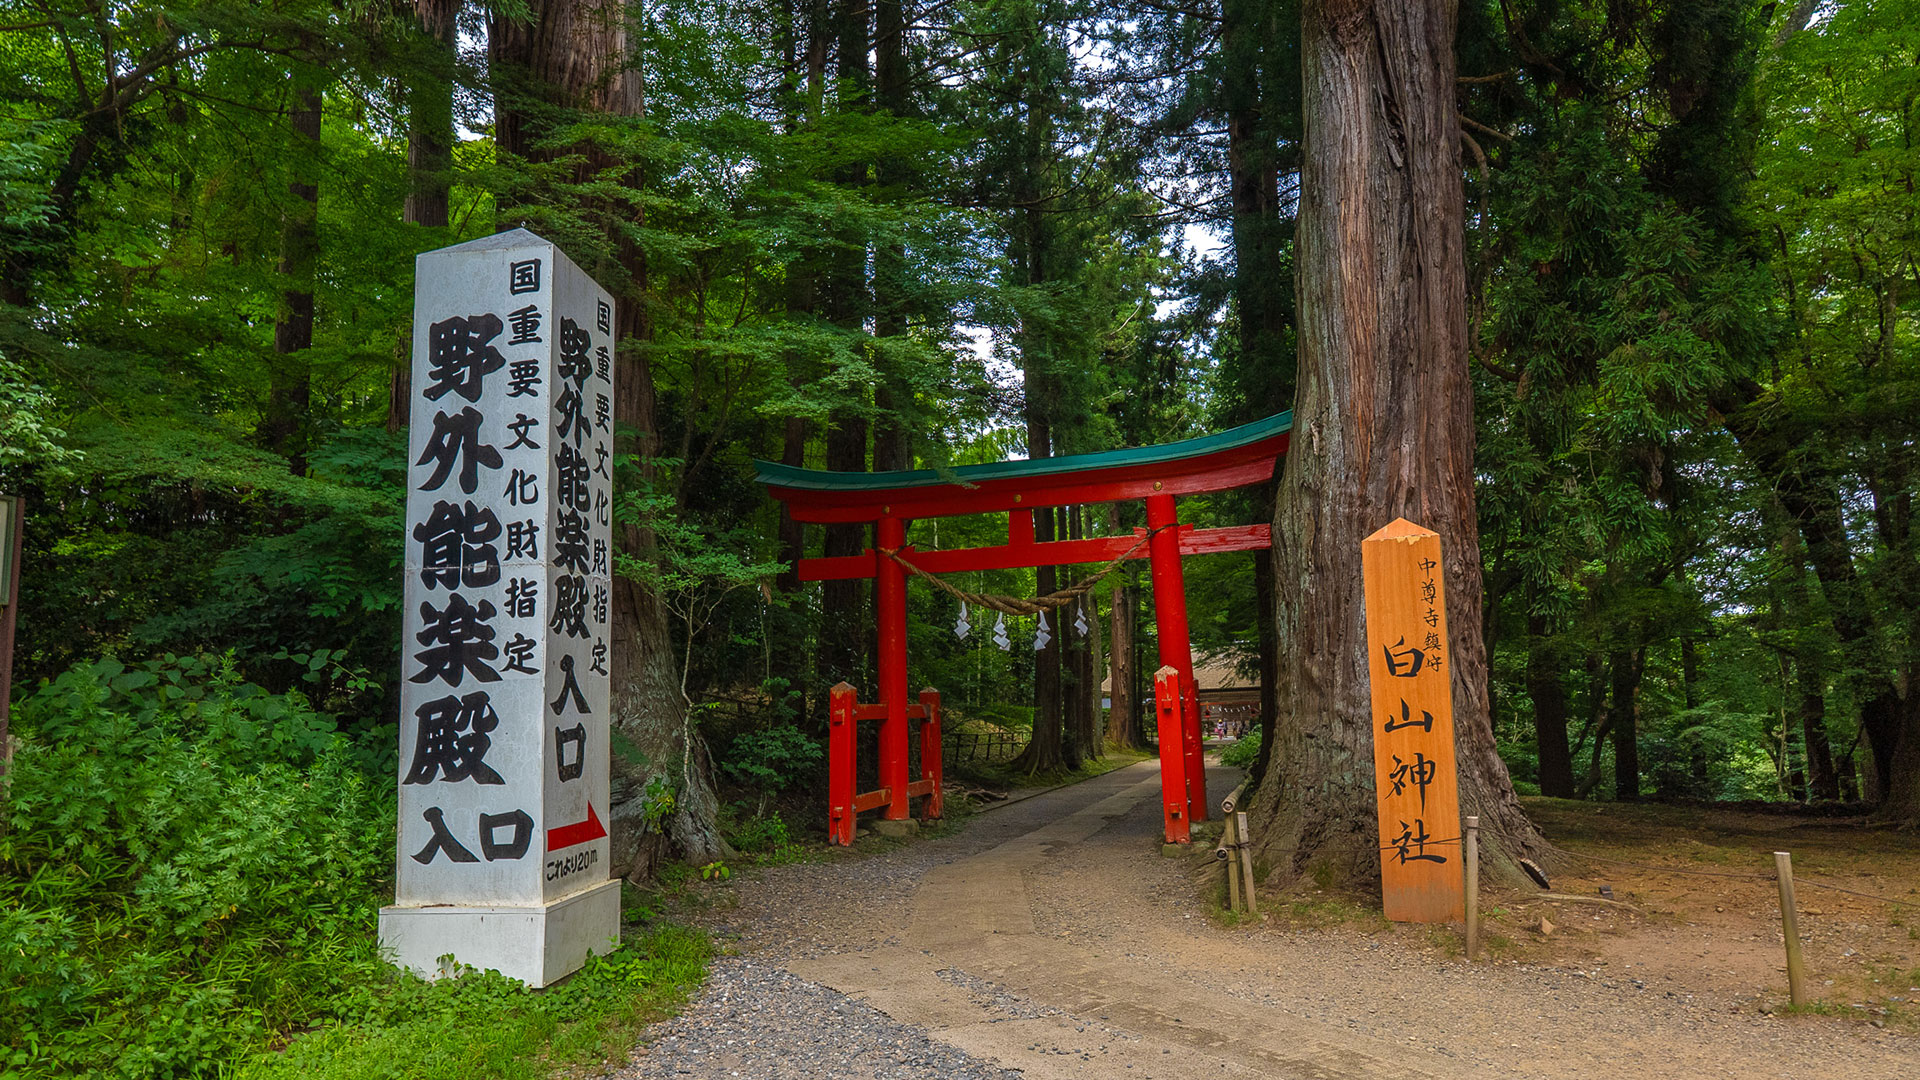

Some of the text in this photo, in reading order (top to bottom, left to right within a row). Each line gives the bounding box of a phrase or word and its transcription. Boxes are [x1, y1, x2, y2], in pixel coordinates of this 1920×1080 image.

[403, 313, 506, 785] 野外能楽殿
[500, 258, 543, 675] 国重要文化財指定
[590, 297, 611, 676] 国重要文化財指定
[1418, 558, 1442, 672] 中尊寺鎮守
[410, 806, 534, 864] 入口
[1384, 635, 1447, 865] 白山神社
